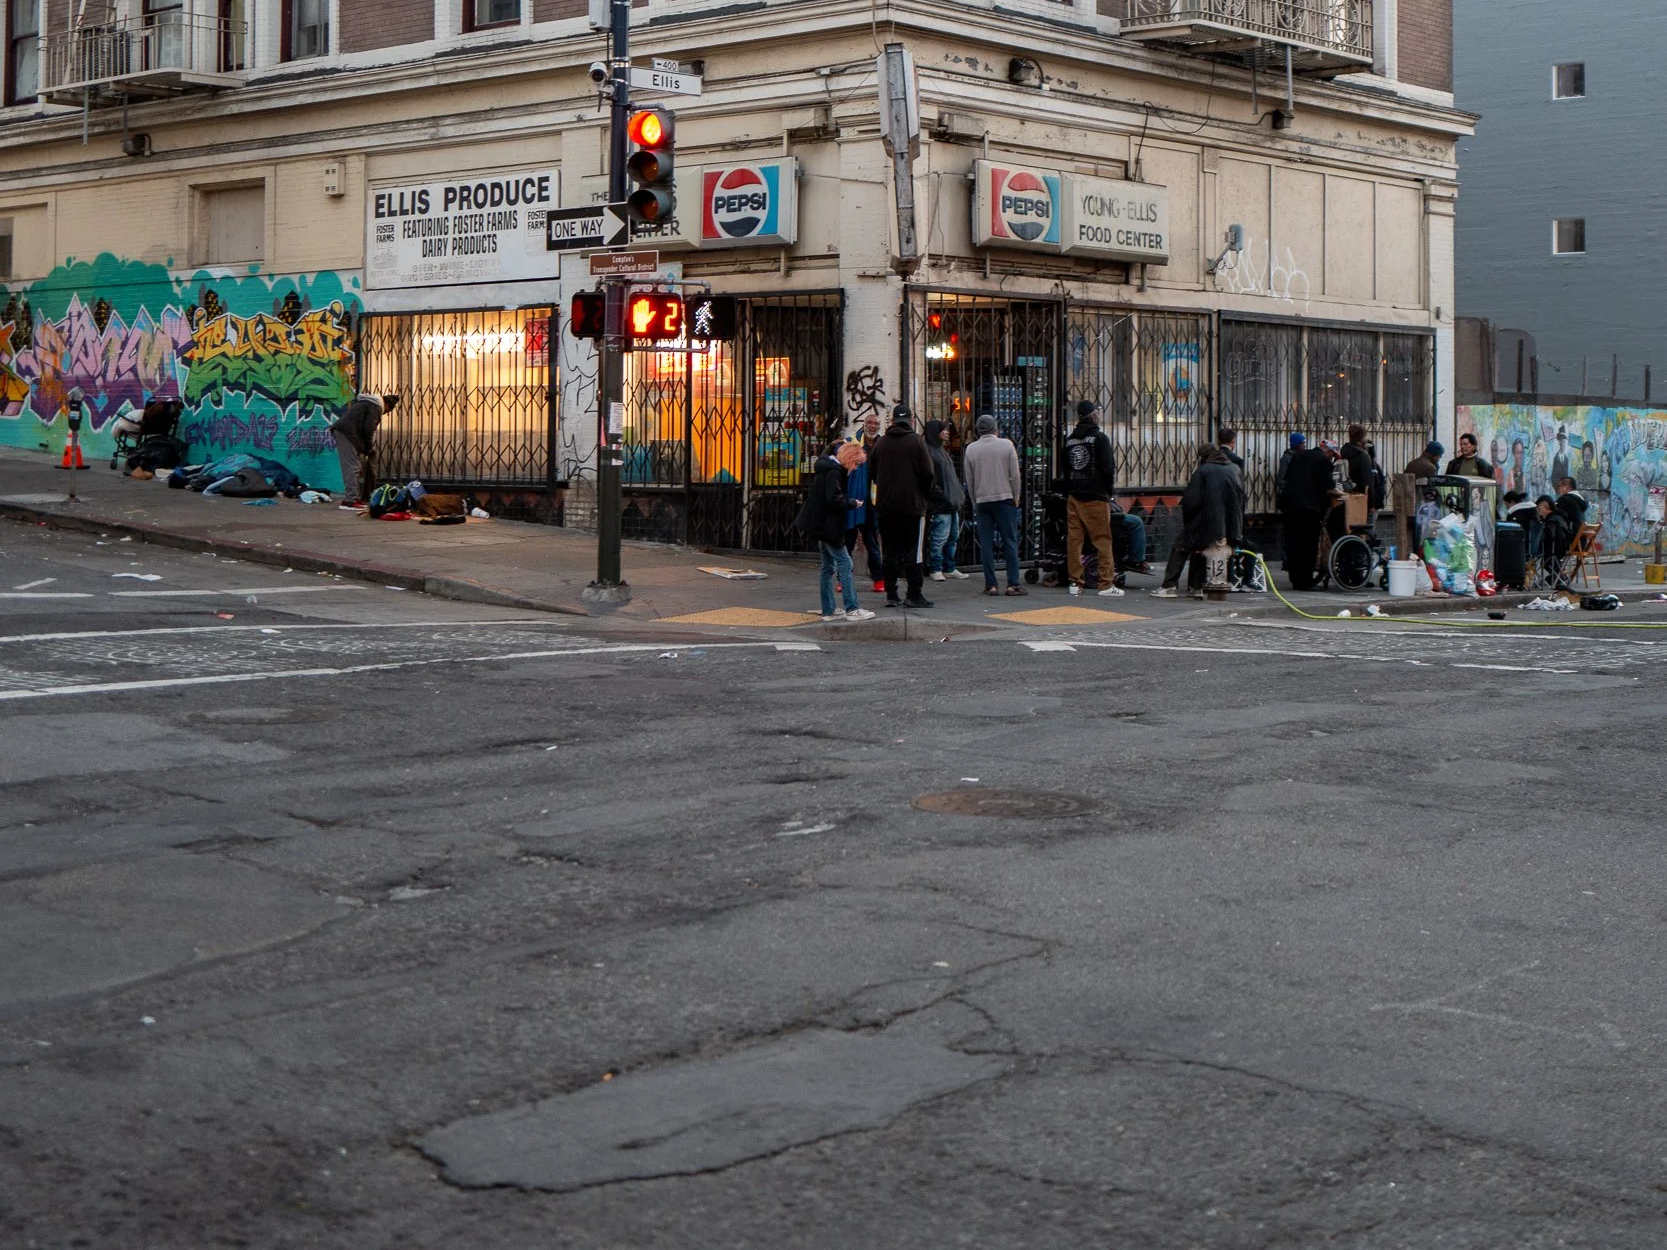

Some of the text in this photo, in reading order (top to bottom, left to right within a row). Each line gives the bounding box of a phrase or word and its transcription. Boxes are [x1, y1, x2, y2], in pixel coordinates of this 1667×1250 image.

[652, 74, 680, 89] Ellis
[375, 176, 550, 219] ELLIS PRODUCE
[714, 192, 767, 214] PEPSI
[1001, 195, 1050, 219] PEPSI
[402, 210, 518, 239] FEATURING FOSTER FARMS
[527, 209, 547, 221] FOSTE
[376, 224, 395, 235] FOSTER
[527, 220, 547, 230] FARM
[554, 219, 604, 238] ONE WAY
[376, 233, 395, 244] FARMS
[422, 234, 498, 258] DAIRY PRODUCTS
[1079, 224, 1163, 250] FOOD CENTER
[612, 254, 635, 265] Compton's
[638, 262, 655, 271] District
[664, 302, 678, 331] 2
